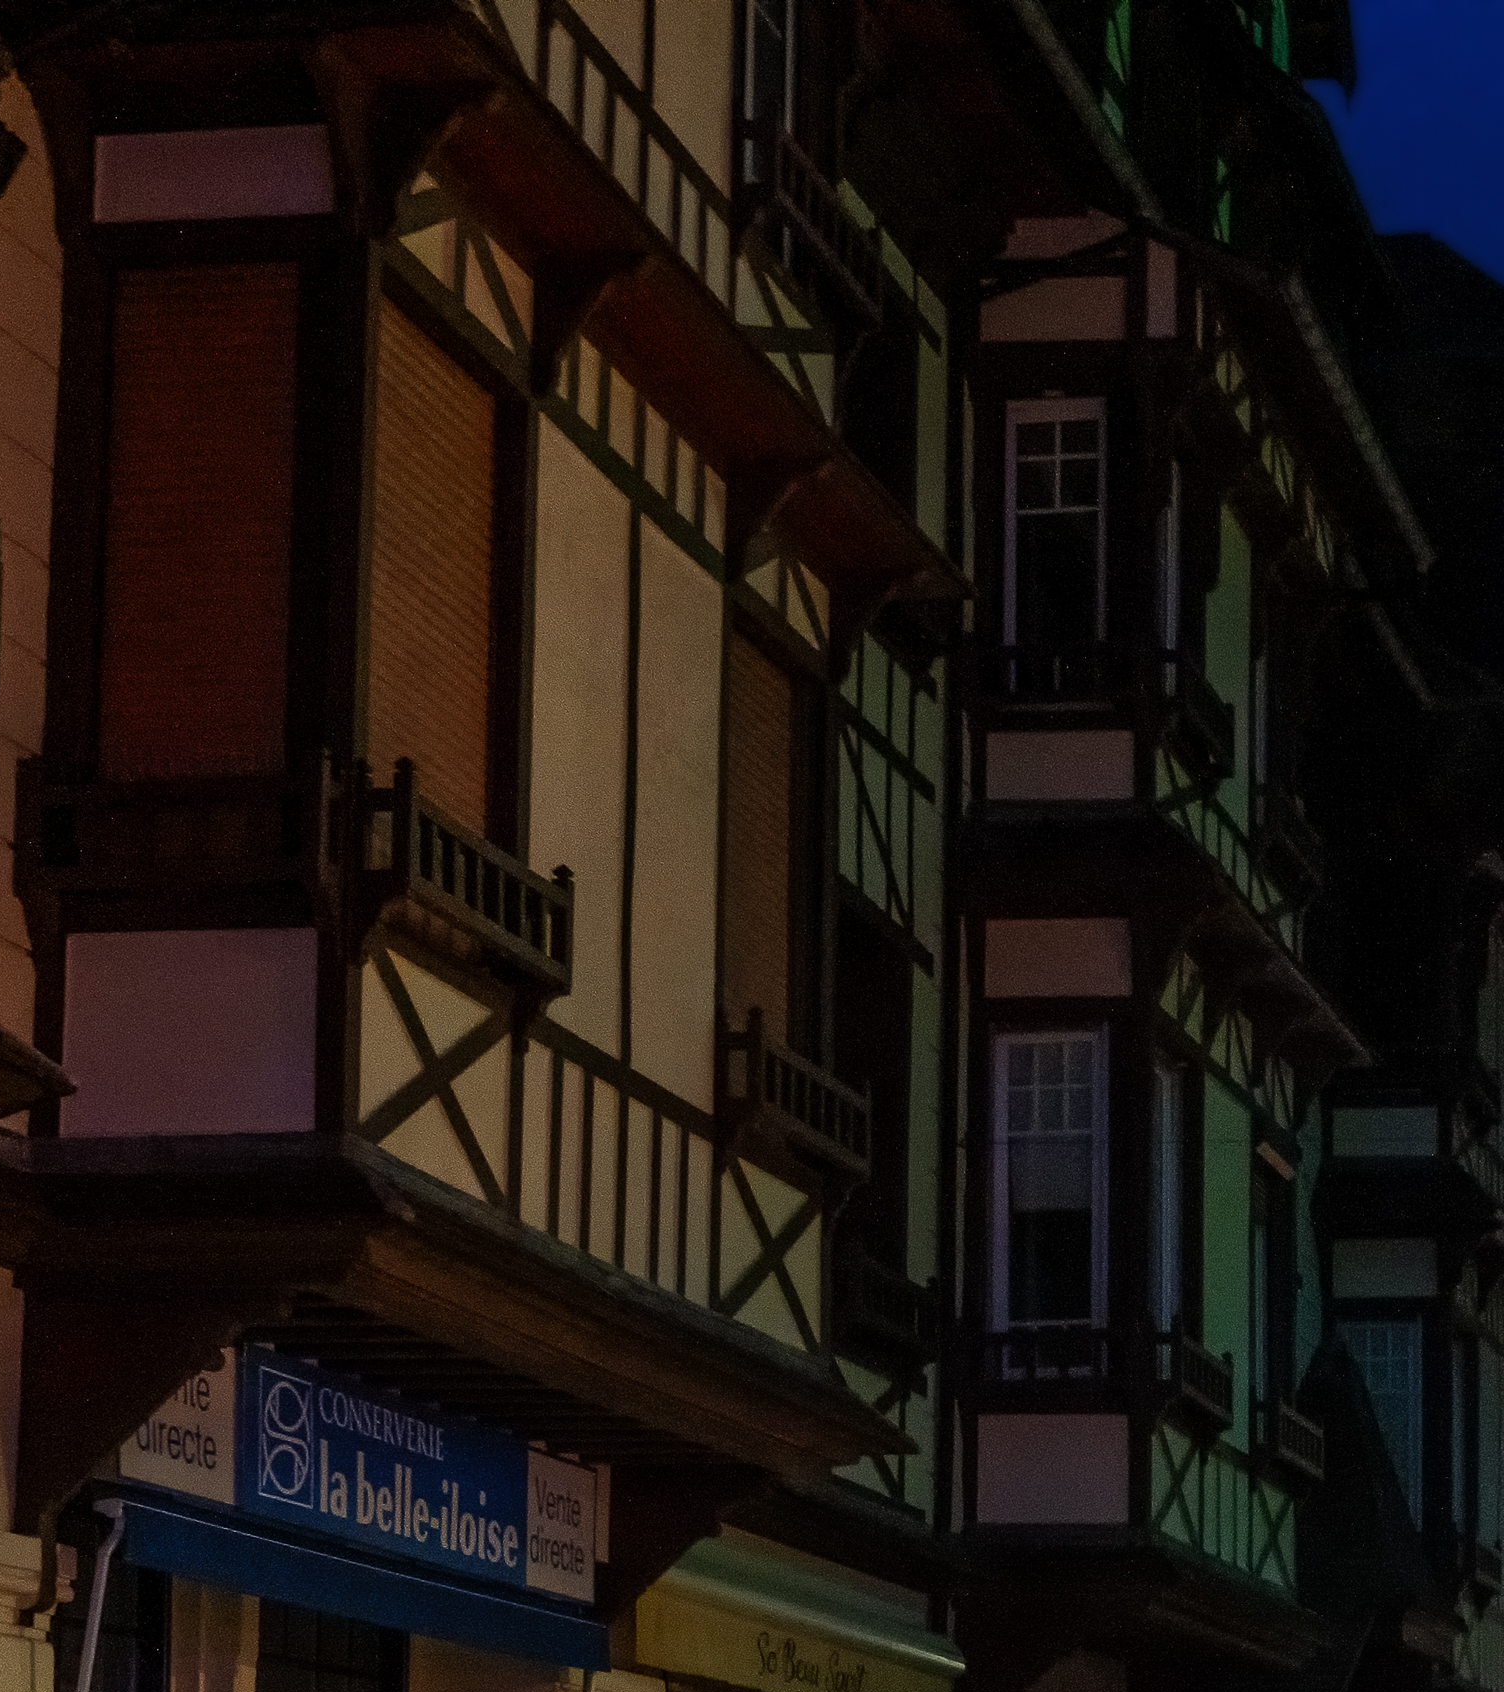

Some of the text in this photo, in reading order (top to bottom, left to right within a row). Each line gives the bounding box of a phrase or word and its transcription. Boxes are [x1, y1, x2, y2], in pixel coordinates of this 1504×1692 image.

[317, 1386, 446, 1463] CONSERVERIE
[318, 1438, 520, 1569] la belle-iloise
[534, 1475, 582, 1529] Vente
[529, 1526, 585, 1575] directe
